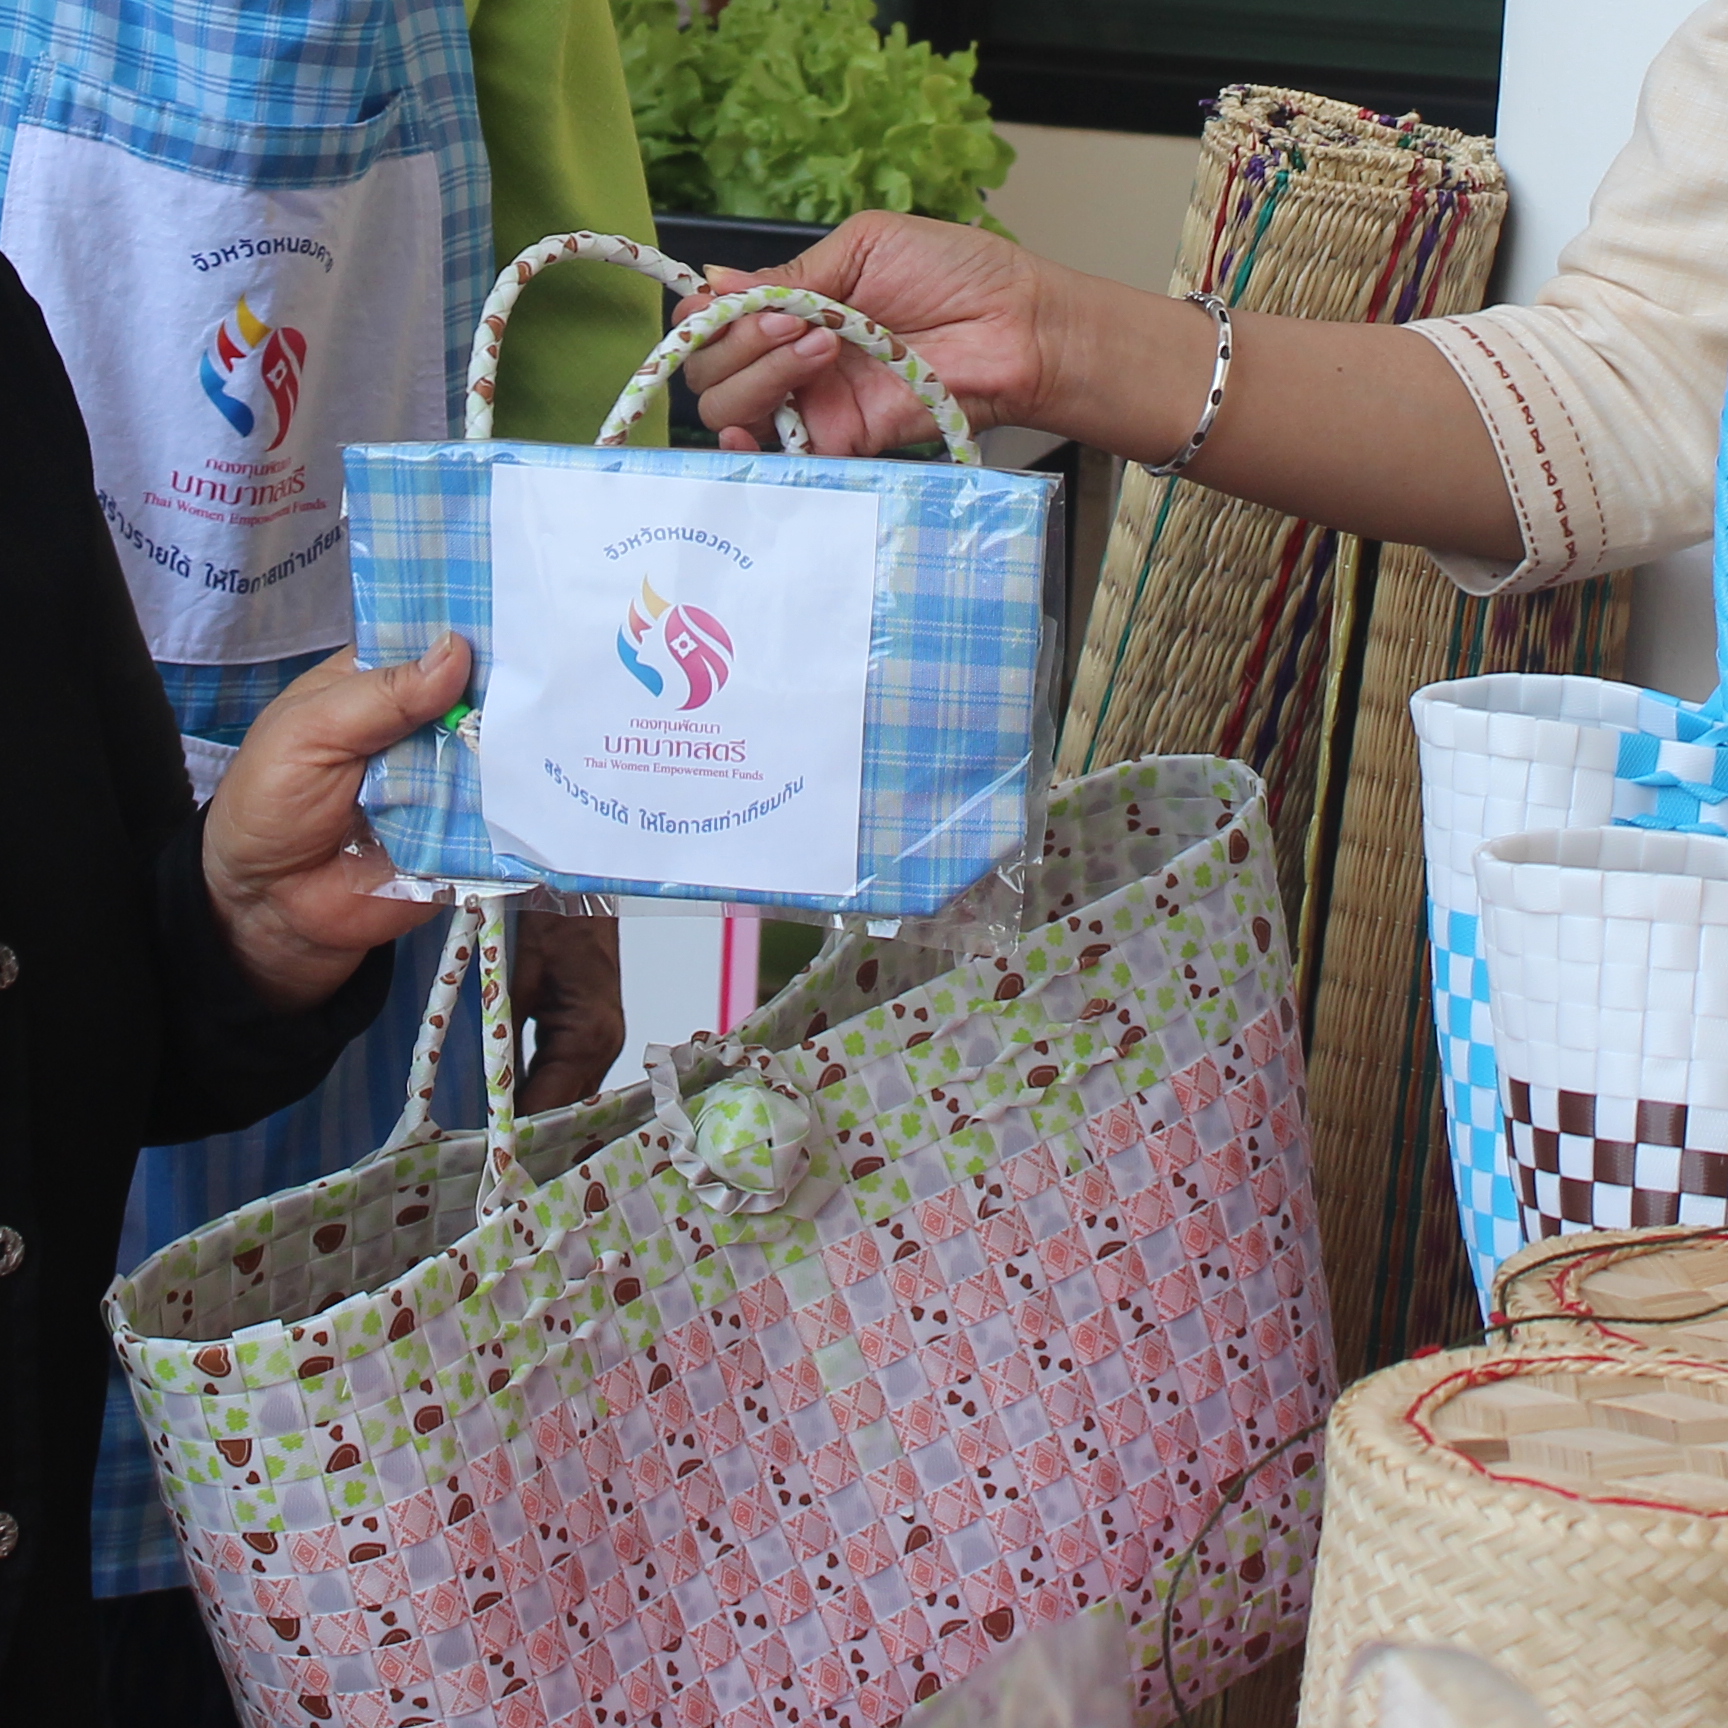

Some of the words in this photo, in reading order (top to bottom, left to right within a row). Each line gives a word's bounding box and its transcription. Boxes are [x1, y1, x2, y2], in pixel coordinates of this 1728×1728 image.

[191, 236, 335, 273] จังหวัดหนองคาย
[170, 465, 306, 506] บทบาทสตรี
[143, 492, 172, 508] Thai
[177, 499, 224, 522] Women
[292, 497, 328, 515] Funds
[603, 526, 754, 571] จังหวัดหนองคาย
[630, 717, 721, 735] กองทุนพัฒนา
[604, 735, 747, 763] บทบาทสตรี
[584, 757, 608, 770] Thai
[610, 758, 650, 773] Women
[653, 762, 729, 779] Empowerment
[732, 768, 764, 781] Funds
[544, 757, 629, 825] สร้างรายได้
[638, 775, 805, 835] ให้โอกาสเท่าเทียมกัน
